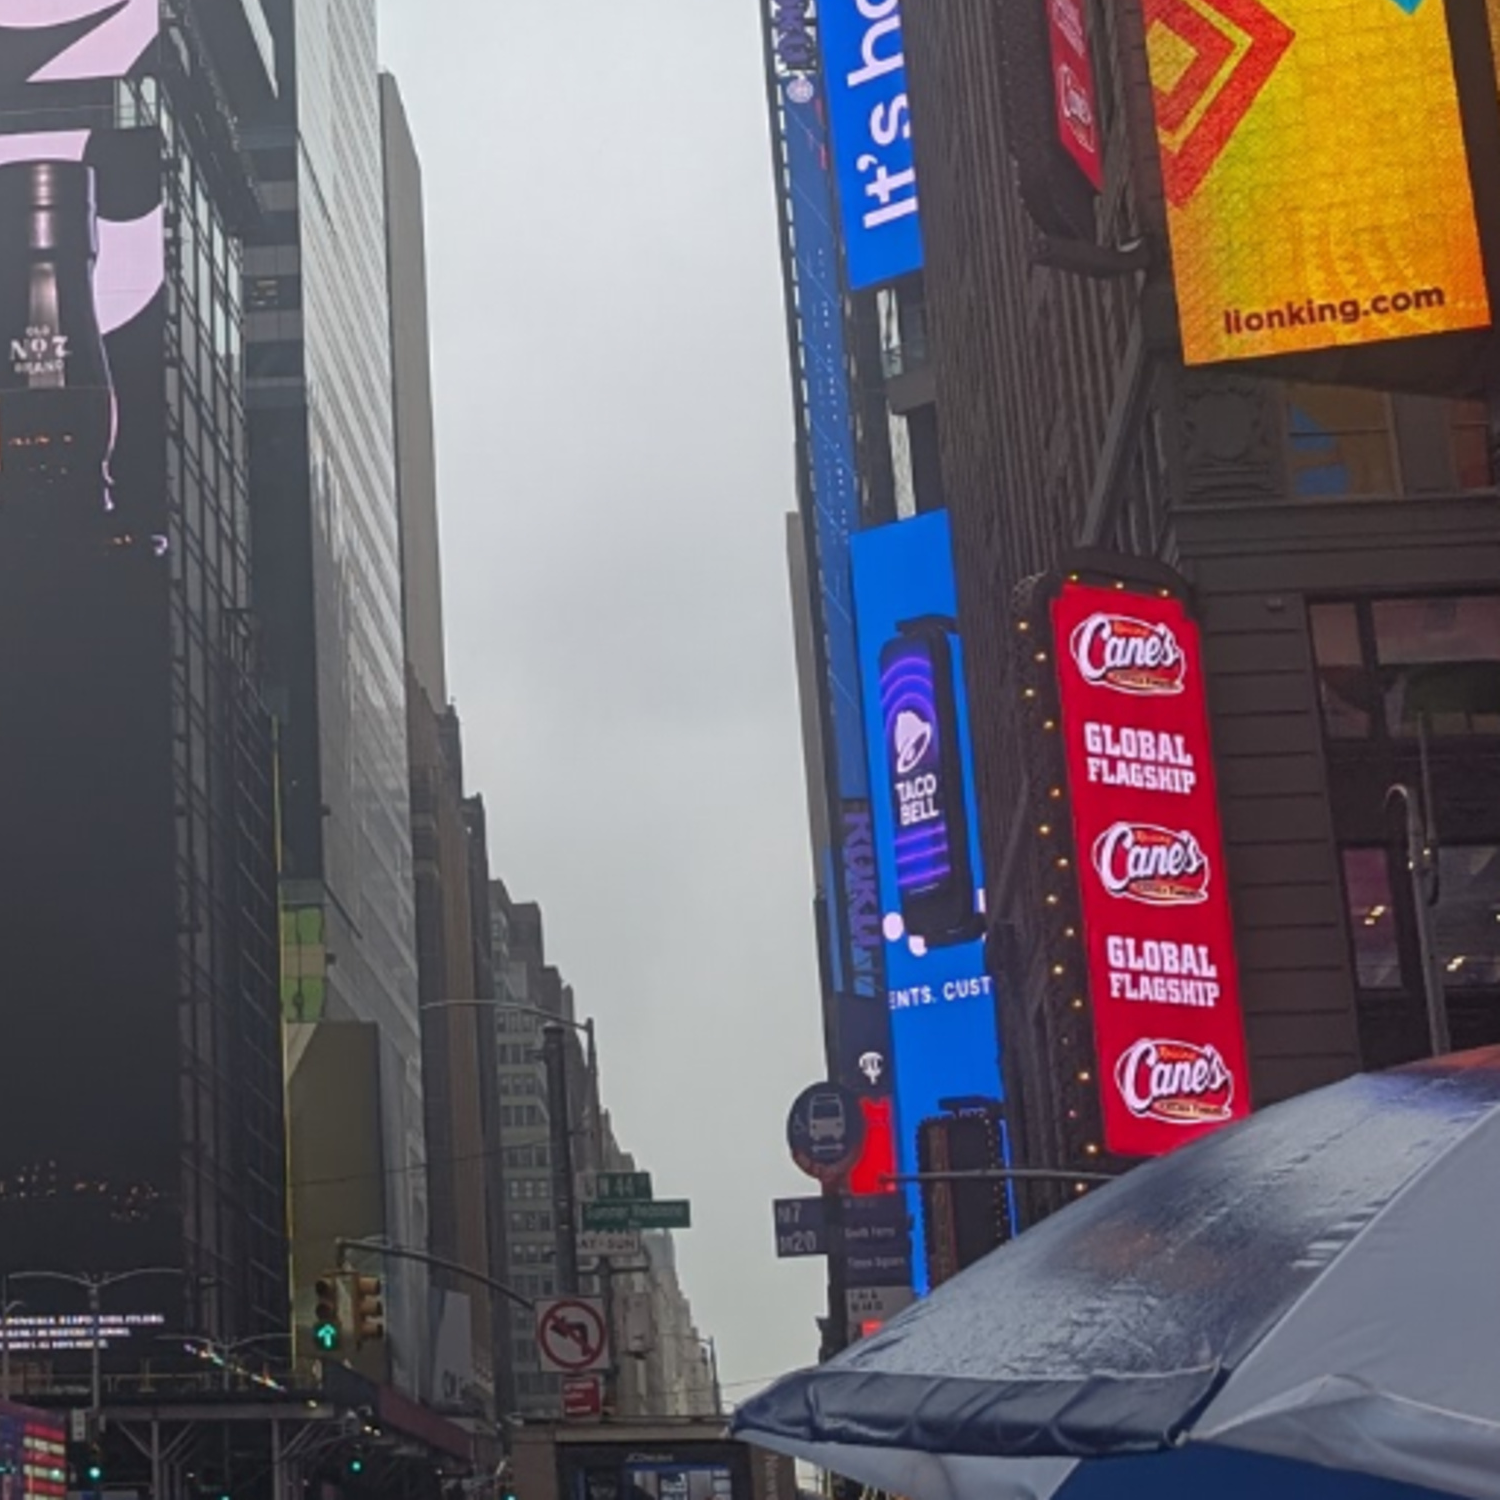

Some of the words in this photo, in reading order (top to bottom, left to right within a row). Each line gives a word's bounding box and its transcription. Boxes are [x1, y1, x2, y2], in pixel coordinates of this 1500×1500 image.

[858, 93, 919, 229] It's
[1222, 285, 1447, 335] lionking.com
[1078, 612, 1179, 681] Cane's
[1084, 720, 1194, 767] GLOBAL
[894, 772, 937, 803] TACO
[1086, 755, 1196, 796] FLAGSHIP
[900, 797, 940, 826] BELL
[1101, 821, 1204, 890] Cane's
[1106, 934, 1218, 979] GLOBAL
[1108, 971, 1221, 1009] FLAGSHIP
[1123, 1039, 1229, 1111] Cane's
